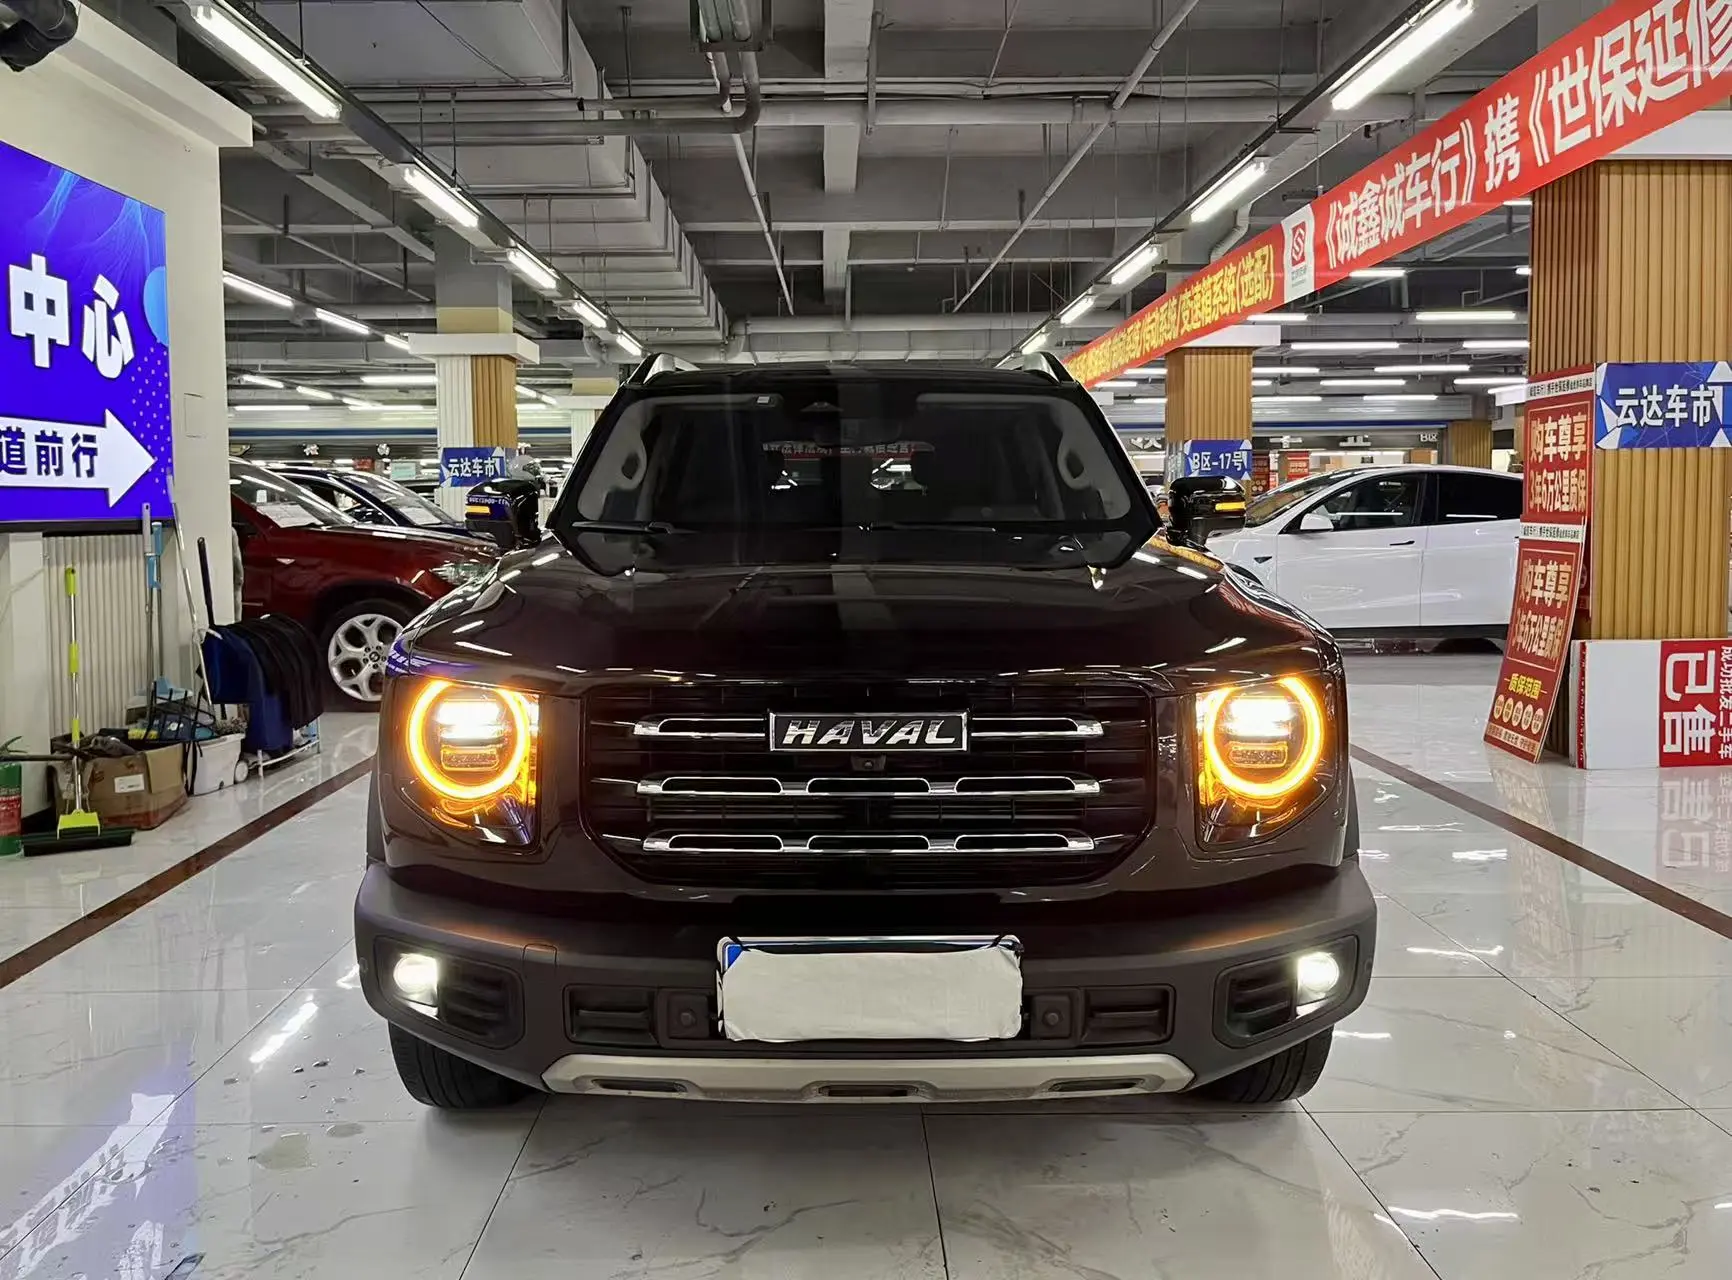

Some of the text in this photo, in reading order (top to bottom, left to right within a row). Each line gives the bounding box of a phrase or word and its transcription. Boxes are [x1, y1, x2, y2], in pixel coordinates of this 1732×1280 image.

[9, 253, 135, 379] 中心
[1615, 384, 1714, 427] 云达车市
[0, 426, 98, 478] 道前行
[1192, 451, 1243, 471] B区-17号
[1530, 412, 1587, 463] 购车尊享
[448, 457, 496, 478] 云达车市
[1529, 468, 1586, 512] 3年6万公里质保
[1520, 559, 1571, 609] 购车尊享
[1662, 650, 1717, 755] 已售
[782, 720, 956, 745] HAVAL
